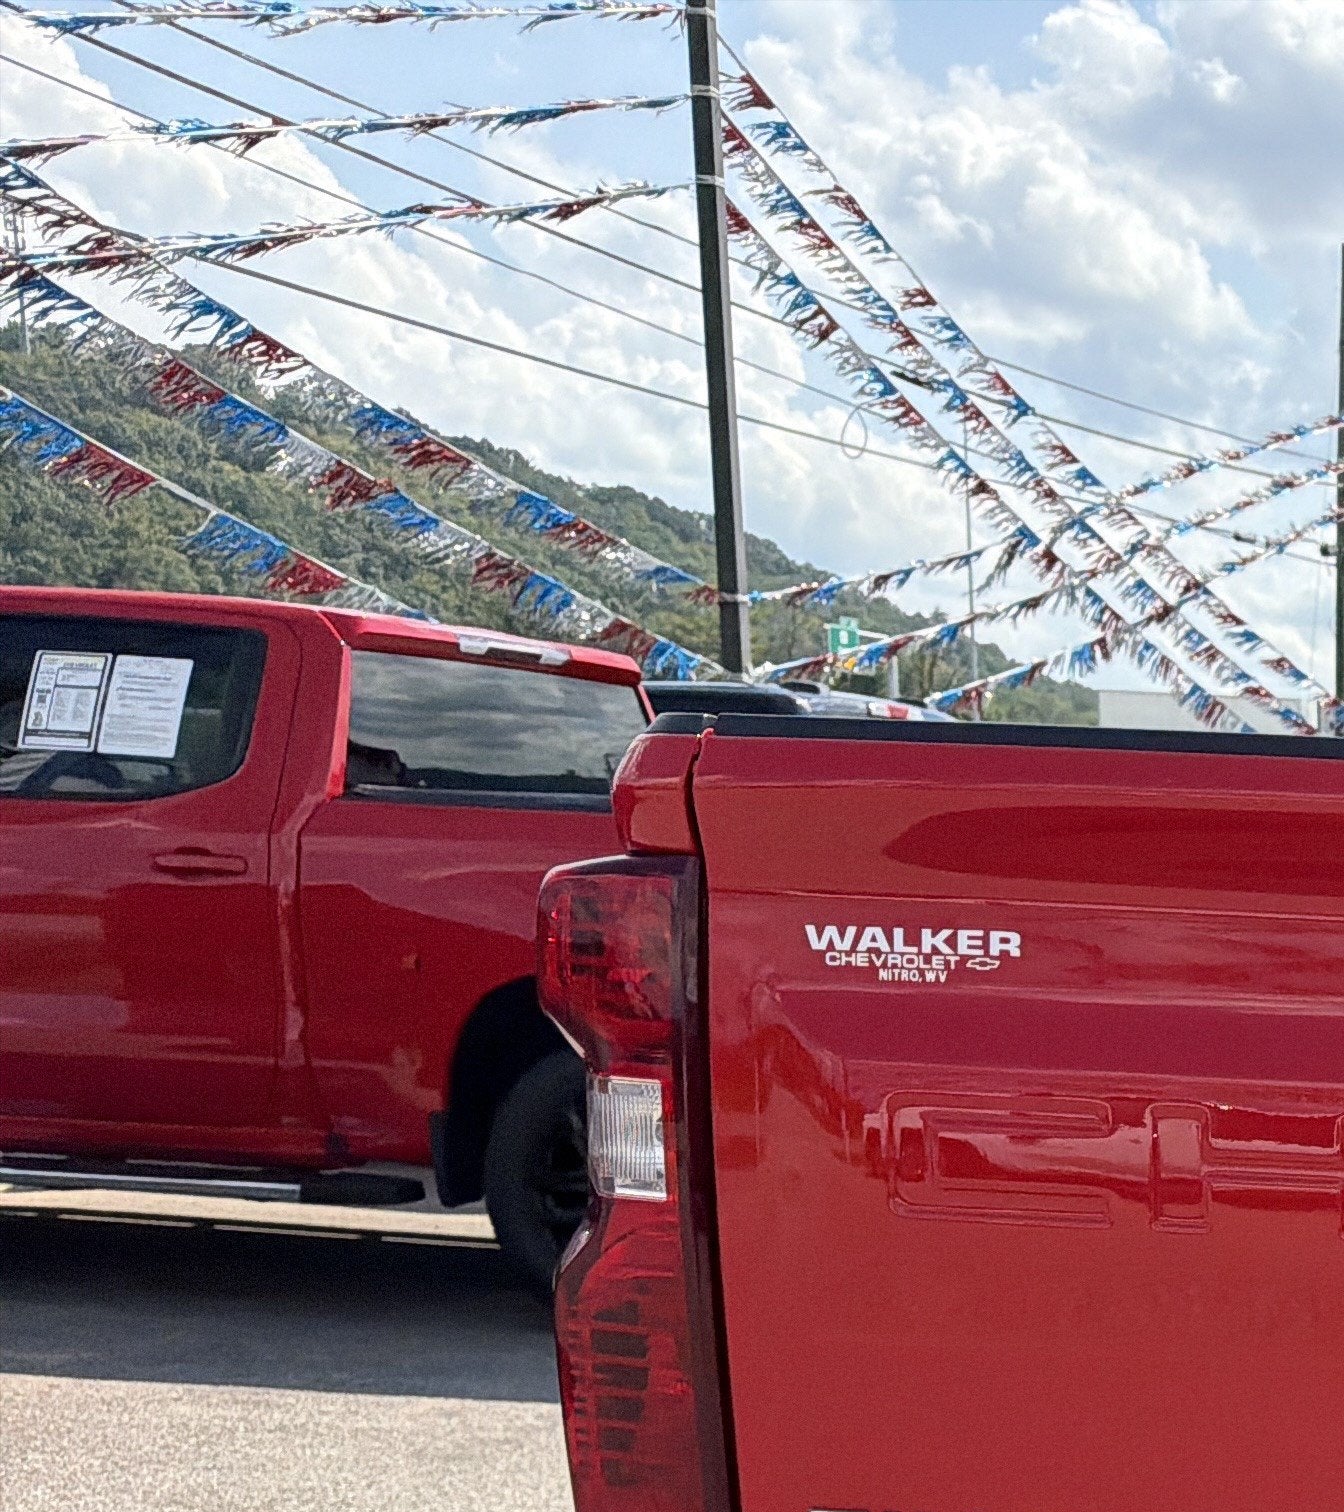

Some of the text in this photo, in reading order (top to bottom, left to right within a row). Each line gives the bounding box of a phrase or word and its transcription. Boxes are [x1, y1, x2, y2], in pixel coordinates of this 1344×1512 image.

[804, 924, 1021, 957] WALKER
[825, 951, 960, 970] CHEVROLET
[878, 968, 948, 983] NITRO, WV
